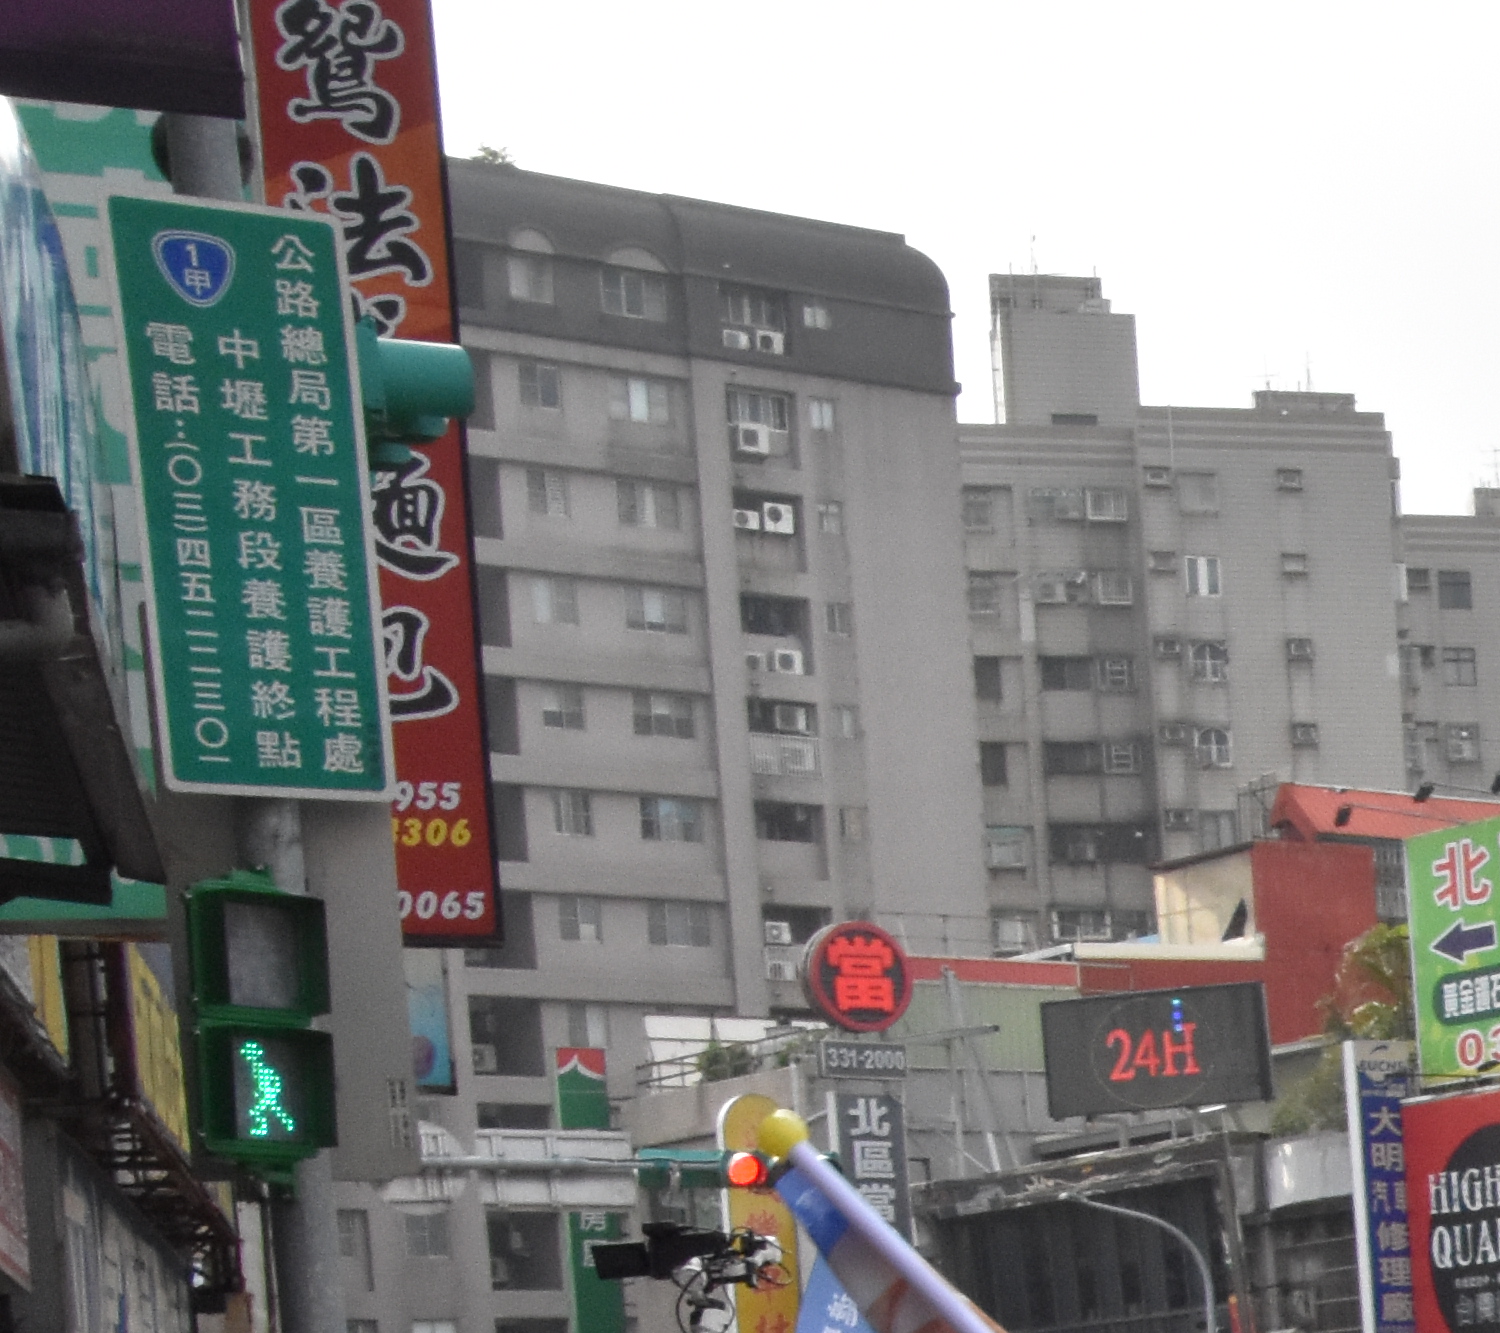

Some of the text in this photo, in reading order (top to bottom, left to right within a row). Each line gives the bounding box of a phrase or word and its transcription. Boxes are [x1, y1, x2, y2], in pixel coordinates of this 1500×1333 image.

[184, 269, 211, 297] 甲
[185, 243, 198, 267] 1
[271, 234, 364, 774] 公路總局第一區養護工程處
[217, 328, 302, 769] 中壢工務段養護終點
[825, 935, 897, 1015] 當
[826, 1043, 906, 1073] 331-2000
[1105, 1020, 1201, 1083] 24H
